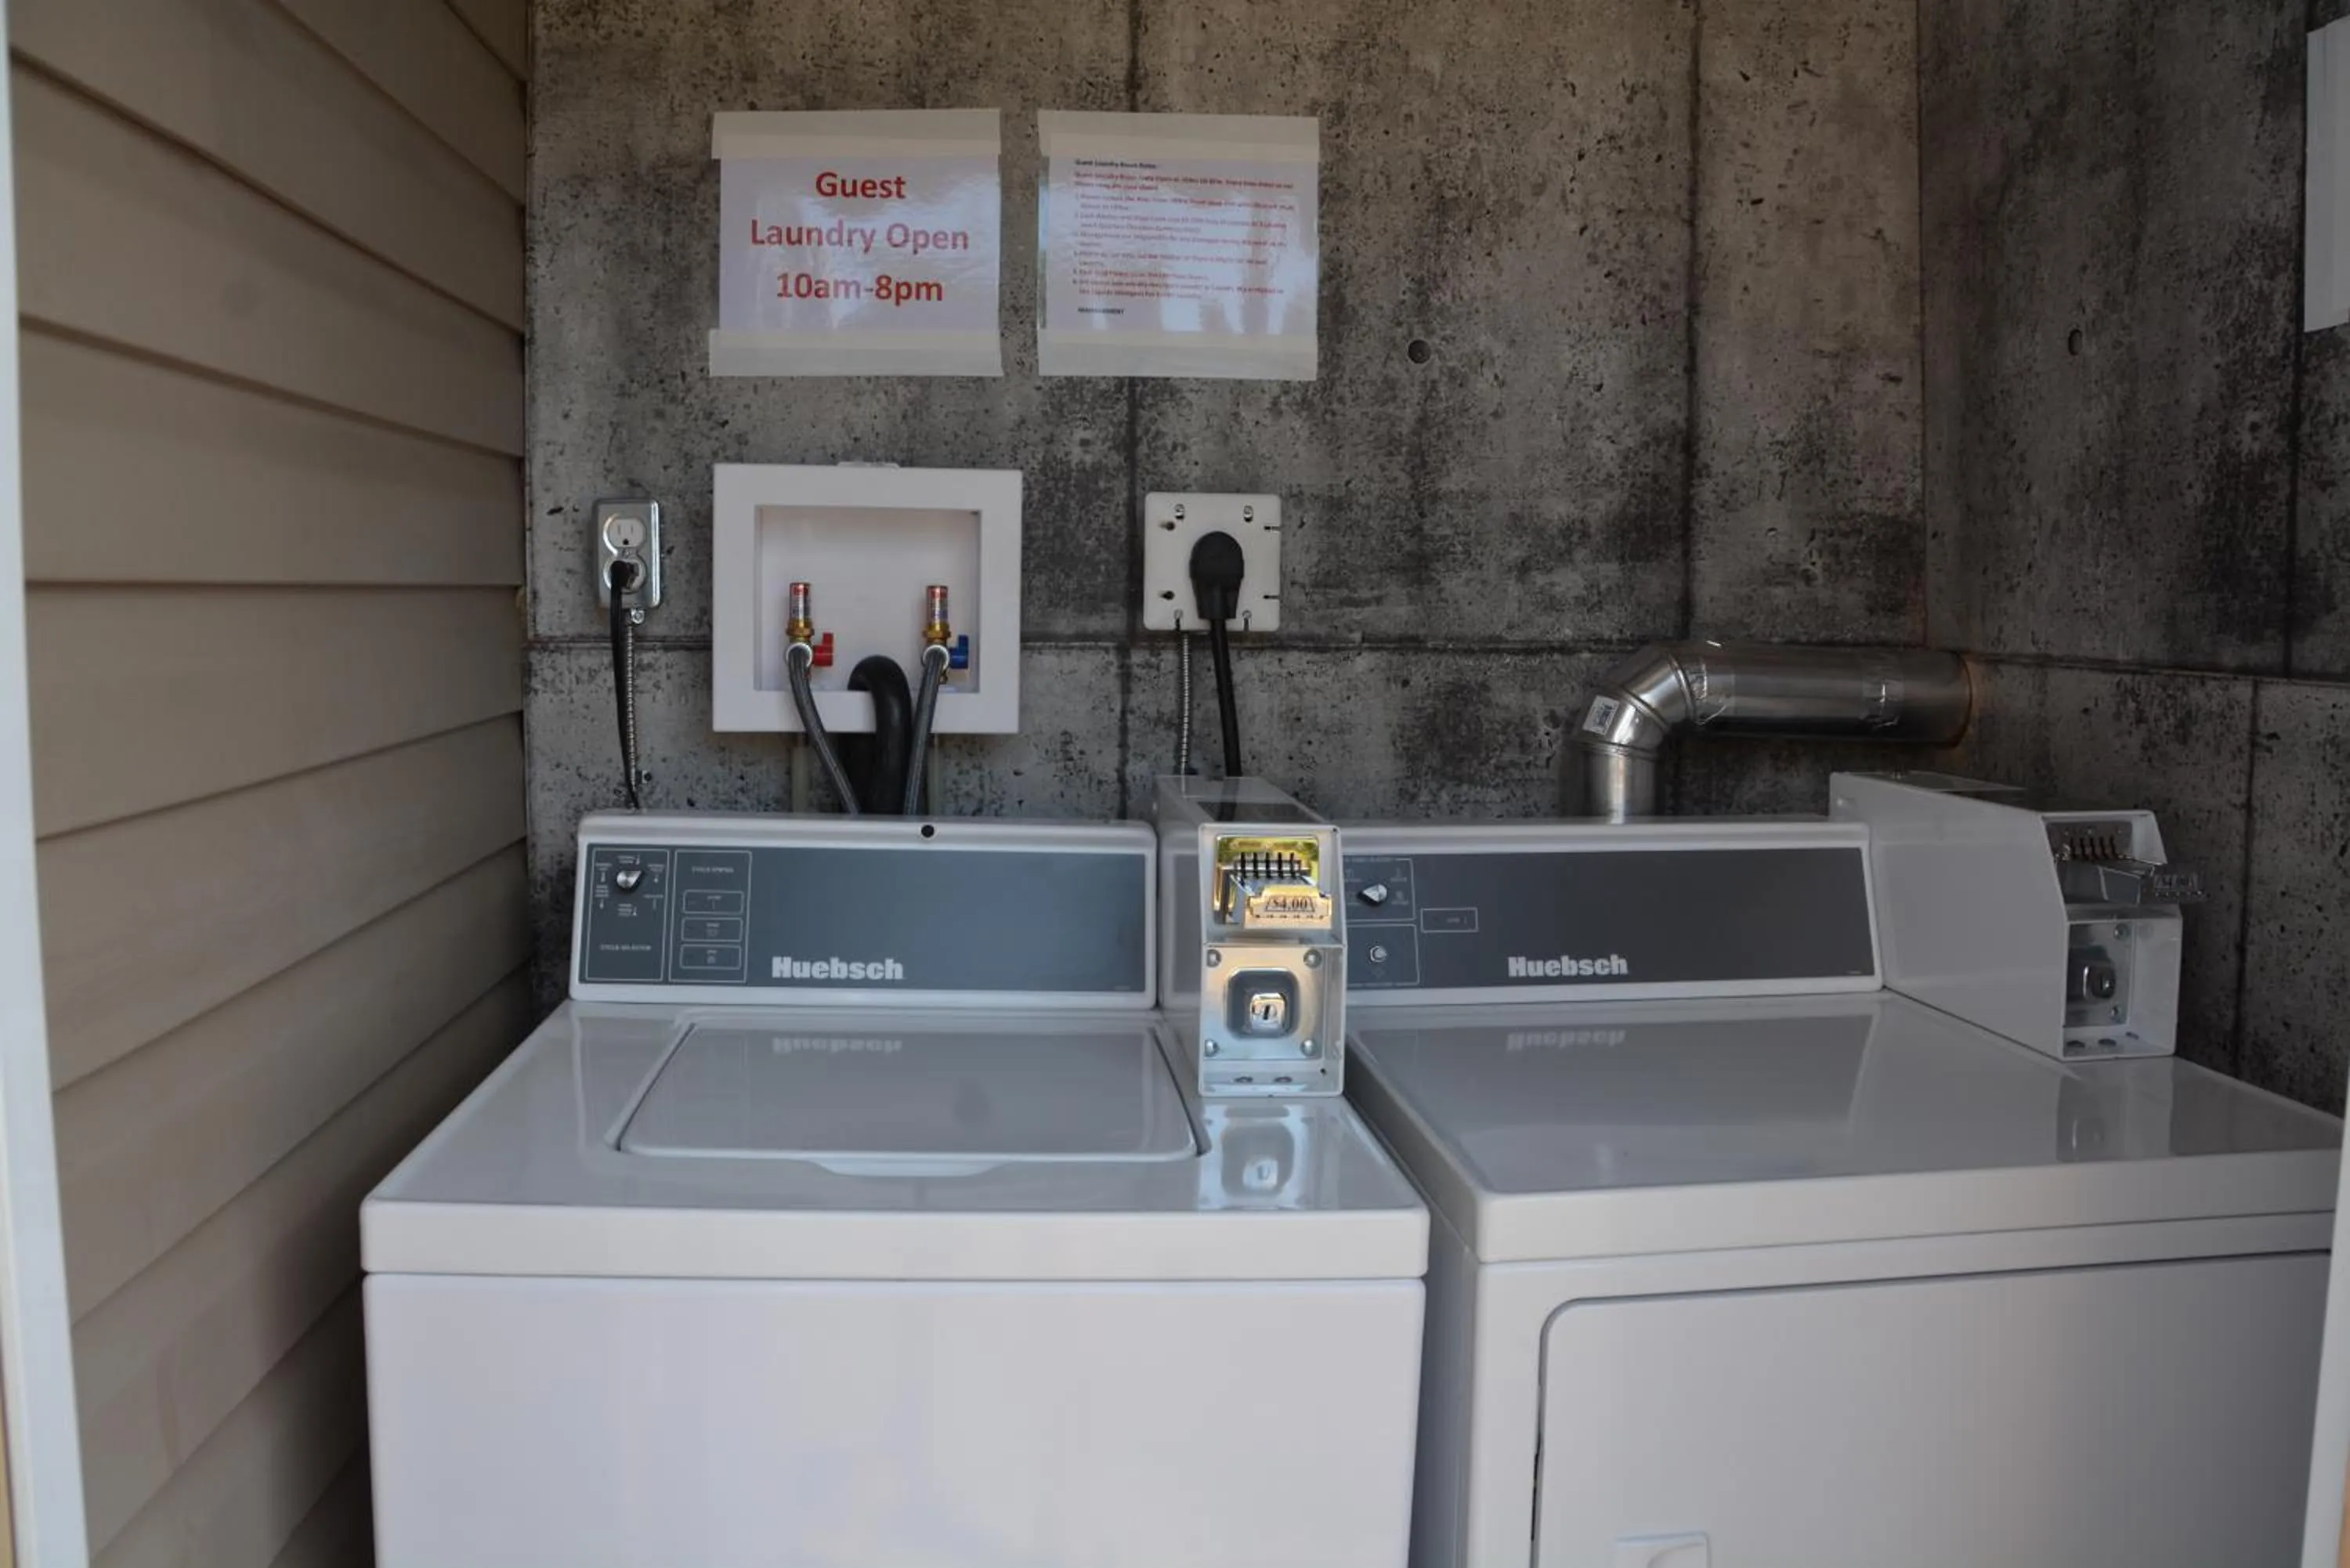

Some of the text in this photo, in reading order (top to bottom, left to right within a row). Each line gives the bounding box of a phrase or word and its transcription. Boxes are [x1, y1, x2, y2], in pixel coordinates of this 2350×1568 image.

[815, 172, 906, 198] Guest
[751, 219, 969, 255] Laundry Open
[776, 273, 943, 305] 10am-8pm
[772, 956, 903, 980] Huebsch
[1507, 954, 1628, 977] Huebsch
